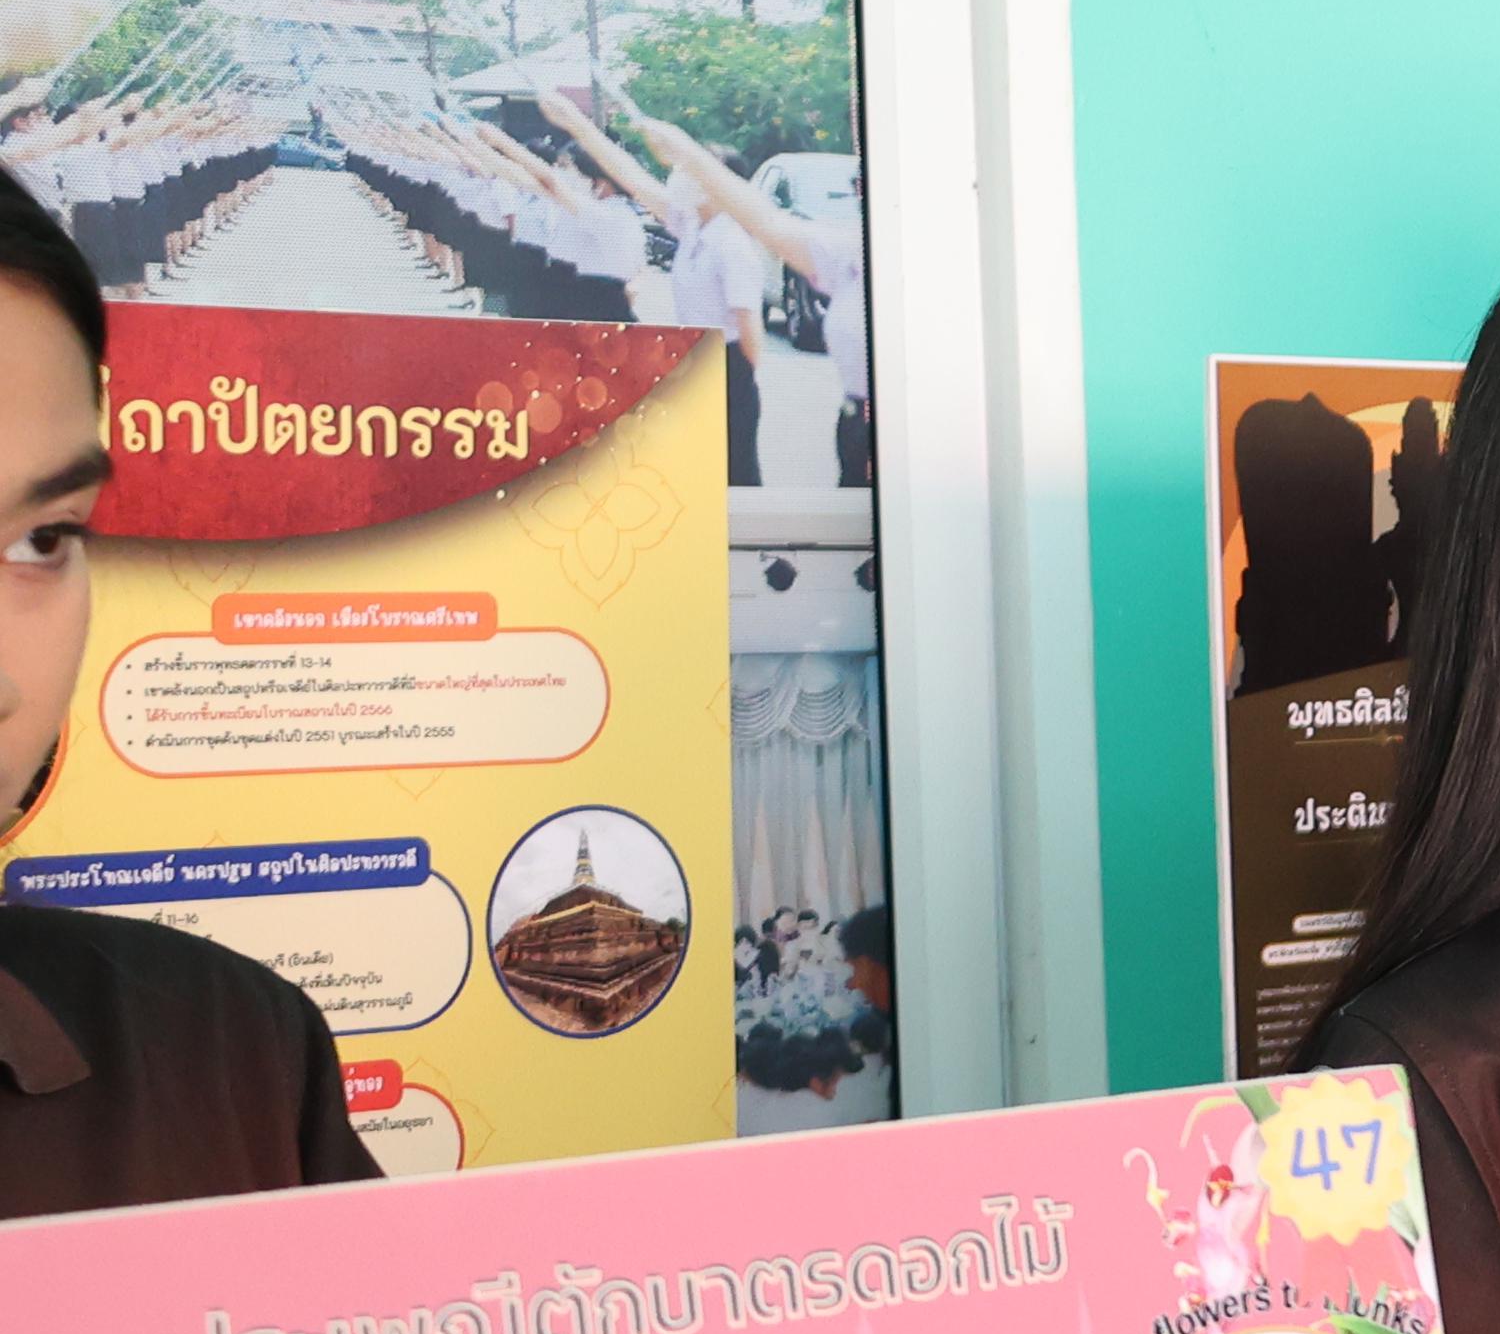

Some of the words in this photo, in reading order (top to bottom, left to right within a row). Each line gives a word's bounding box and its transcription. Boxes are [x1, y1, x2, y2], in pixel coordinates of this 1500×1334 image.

[300, 657, 332, 669] 13-14
[183, 861, 250, 883] นครปฐม
[1290, 1120, 1383, 1192] 47
